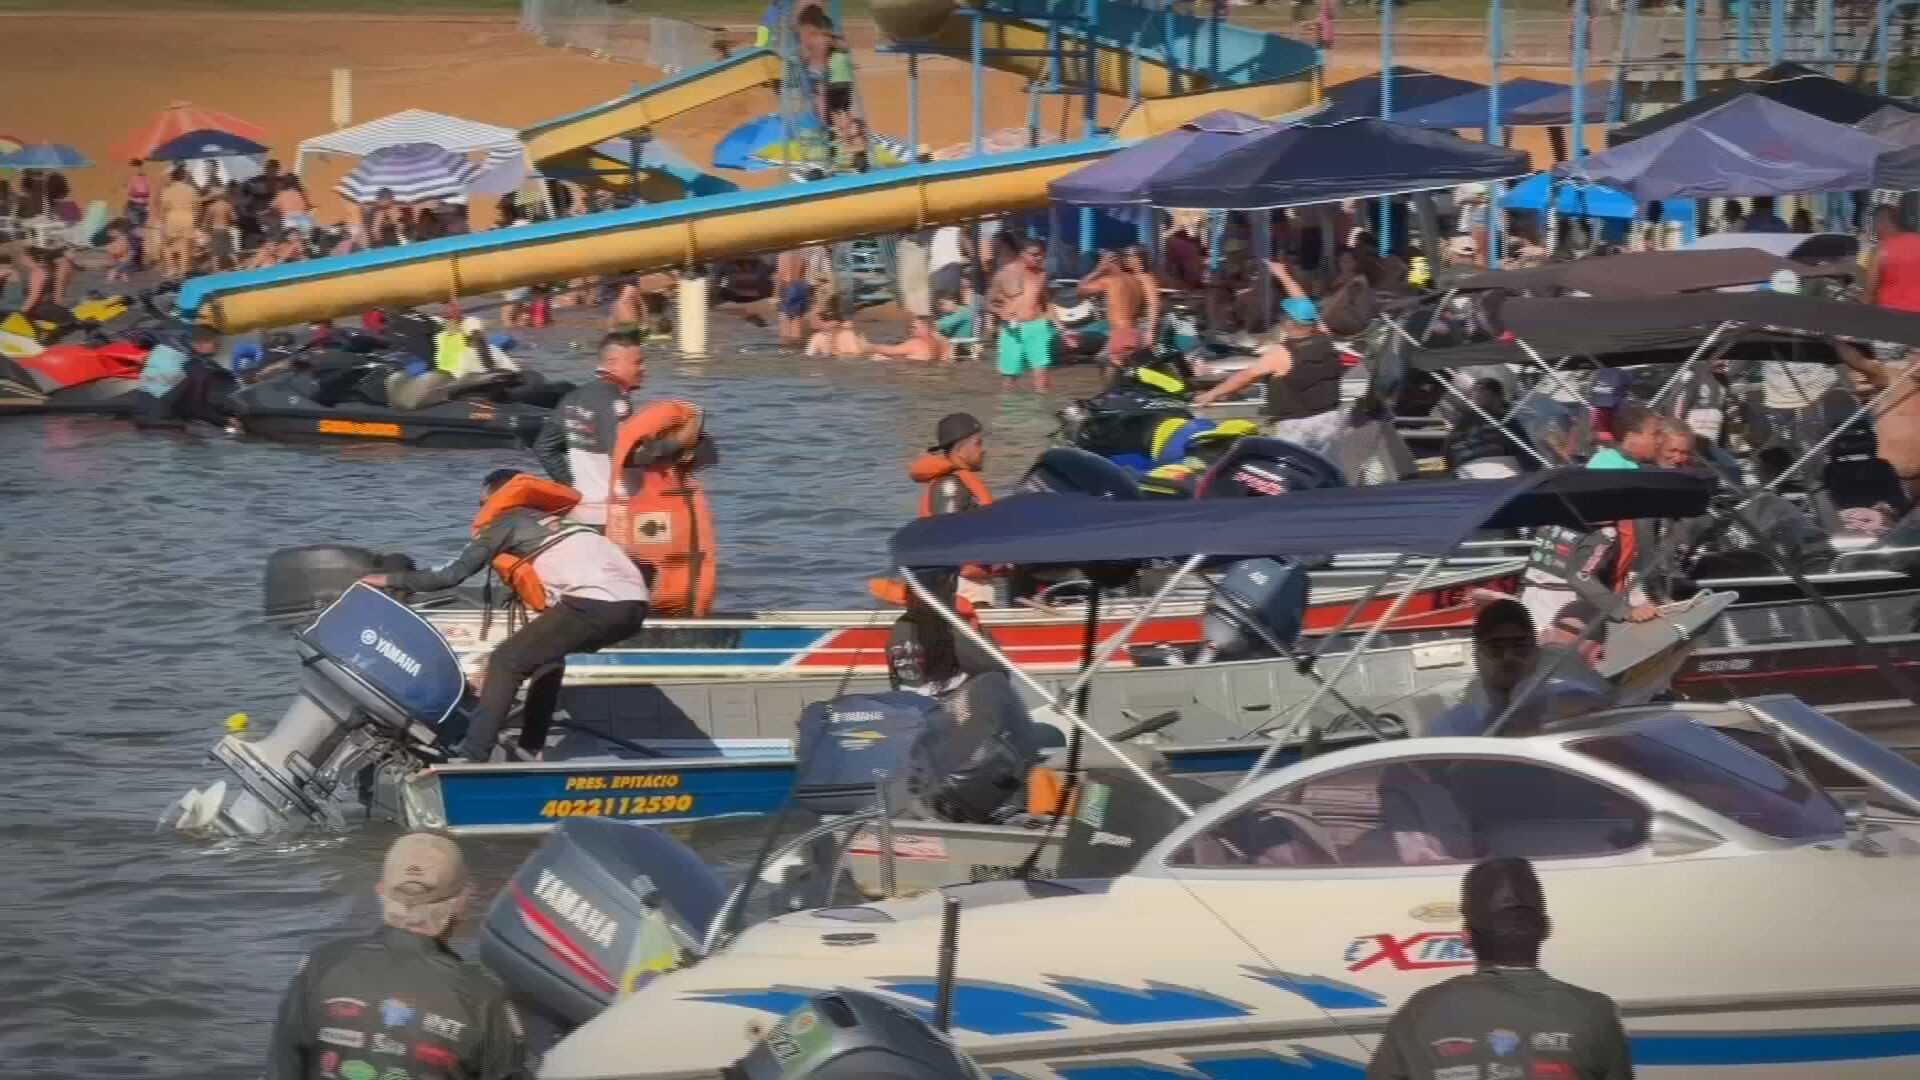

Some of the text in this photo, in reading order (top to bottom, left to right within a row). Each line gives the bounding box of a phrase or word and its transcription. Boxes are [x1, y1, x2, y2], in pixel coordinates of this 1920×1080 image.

[374, 637, 423, 677] YAMAHA
[841, 711, 885, 722] YAMAHA
[565, 775, 607, 791] PRES.
[540, 793, 694, 817] 4022112590
[533, 868, 620, 948] YAMAHA
